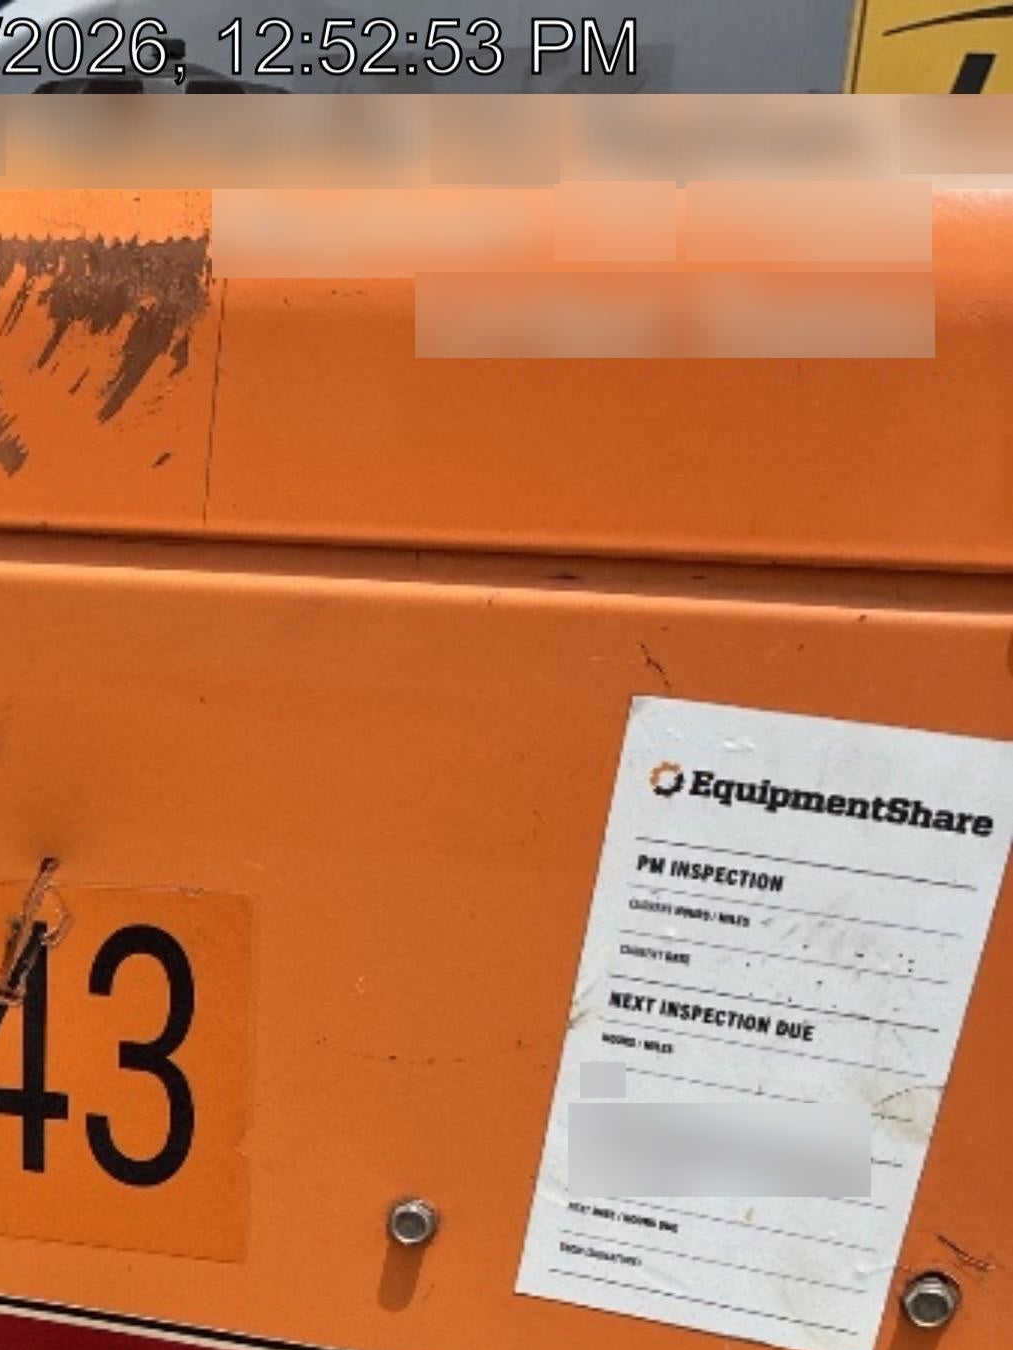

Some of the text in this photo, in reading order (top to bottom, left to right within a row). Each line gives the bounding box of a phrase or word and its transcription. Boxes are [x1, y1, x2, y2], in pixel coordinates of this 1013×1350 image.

[689, 770, 994, 837] EquipmentShare
[637, 854, 784, 892] PM INSPECTION
[608, 991, 816, 1042] NEXT INSPECTION DUE
